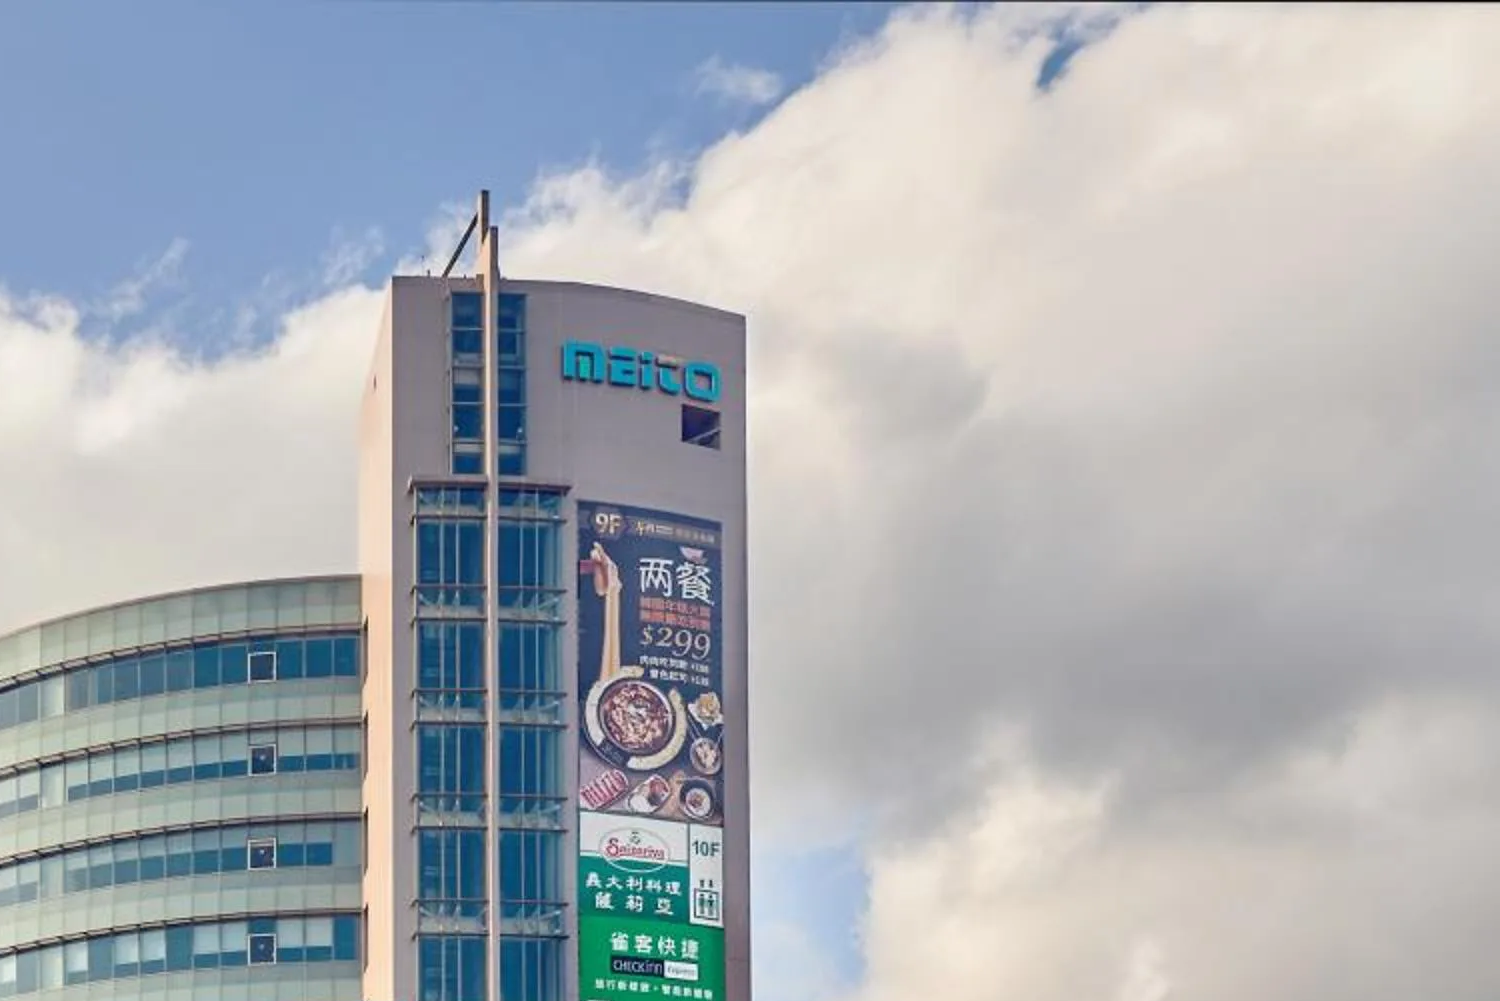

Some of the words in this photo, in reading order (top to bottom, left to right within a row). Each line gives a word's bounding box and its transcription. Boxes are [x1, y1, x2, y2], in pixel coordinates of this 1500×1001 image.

[595, 513, 621, 534] 9F
[639, 625, 711, 660] $299
[691, 840, 720, 857] 10F
